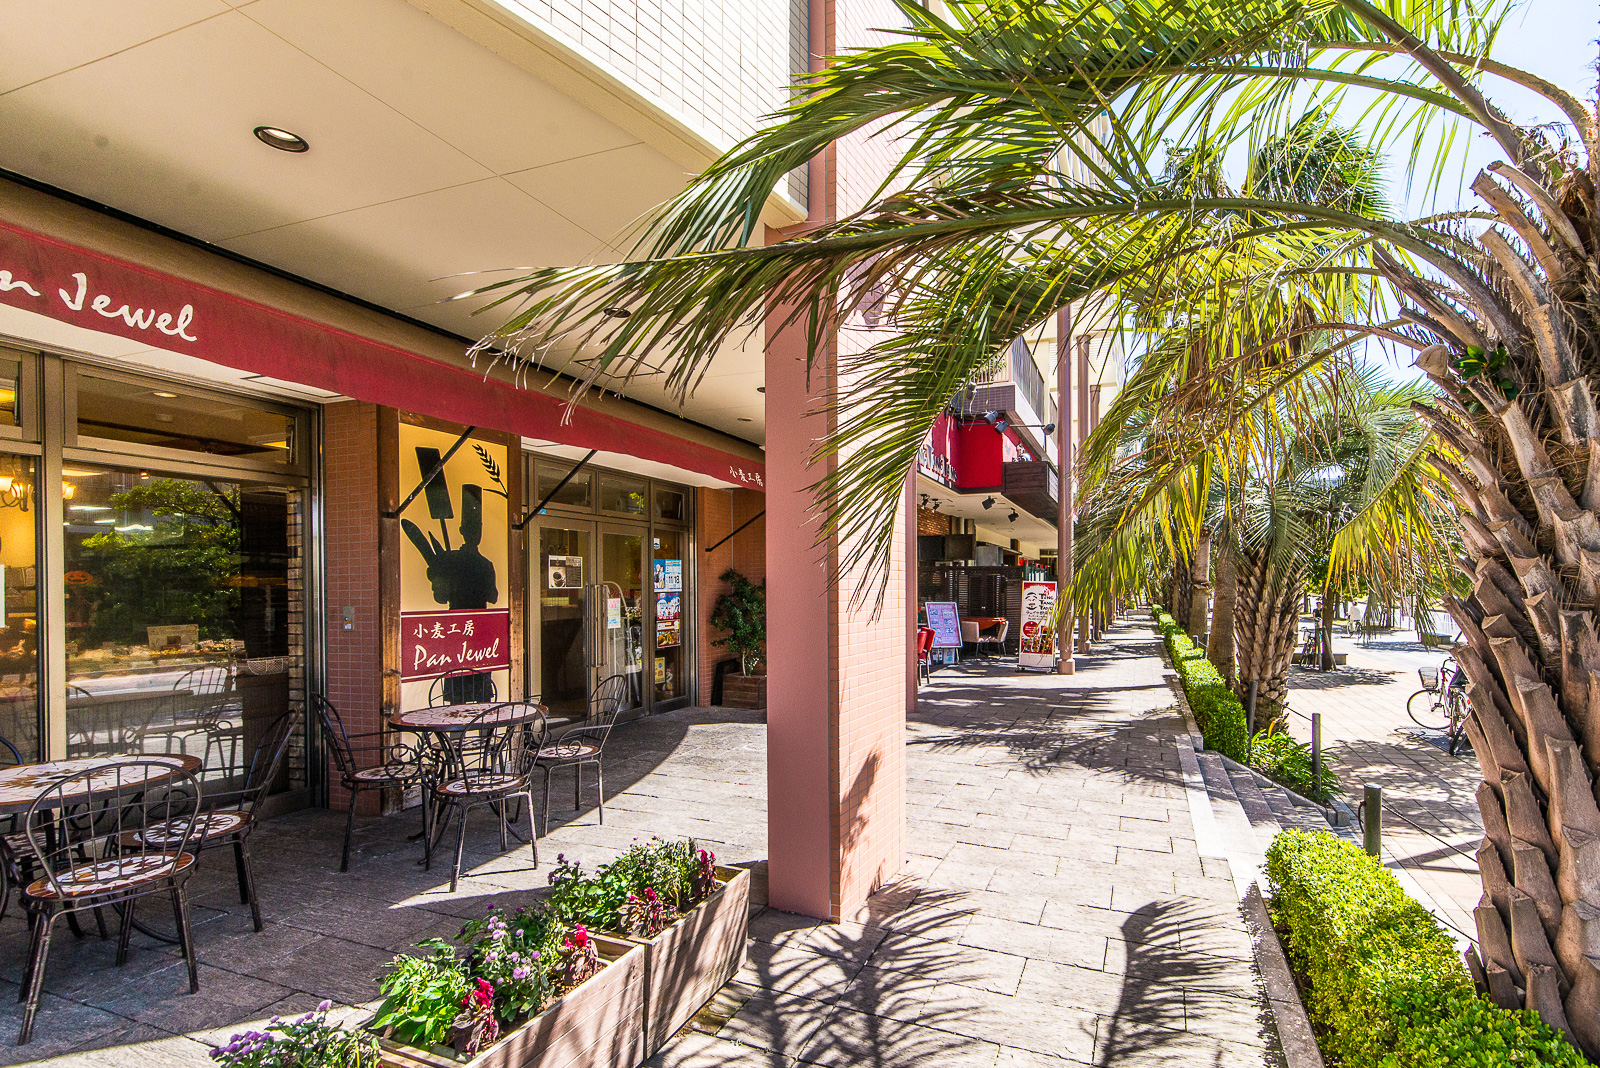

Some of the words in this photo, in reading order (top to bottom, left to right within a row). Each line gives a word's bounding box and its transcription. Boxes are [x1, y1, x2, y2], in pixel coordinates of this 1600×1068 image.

[58, 272, 198, 342] Jewel
[729, 465, 764, 488] 小麦工房
[413, 619, 475, 639] 小麦工房
[413, 644, 452, 671] Pan
[456, 637, 500, 663] Jewel
